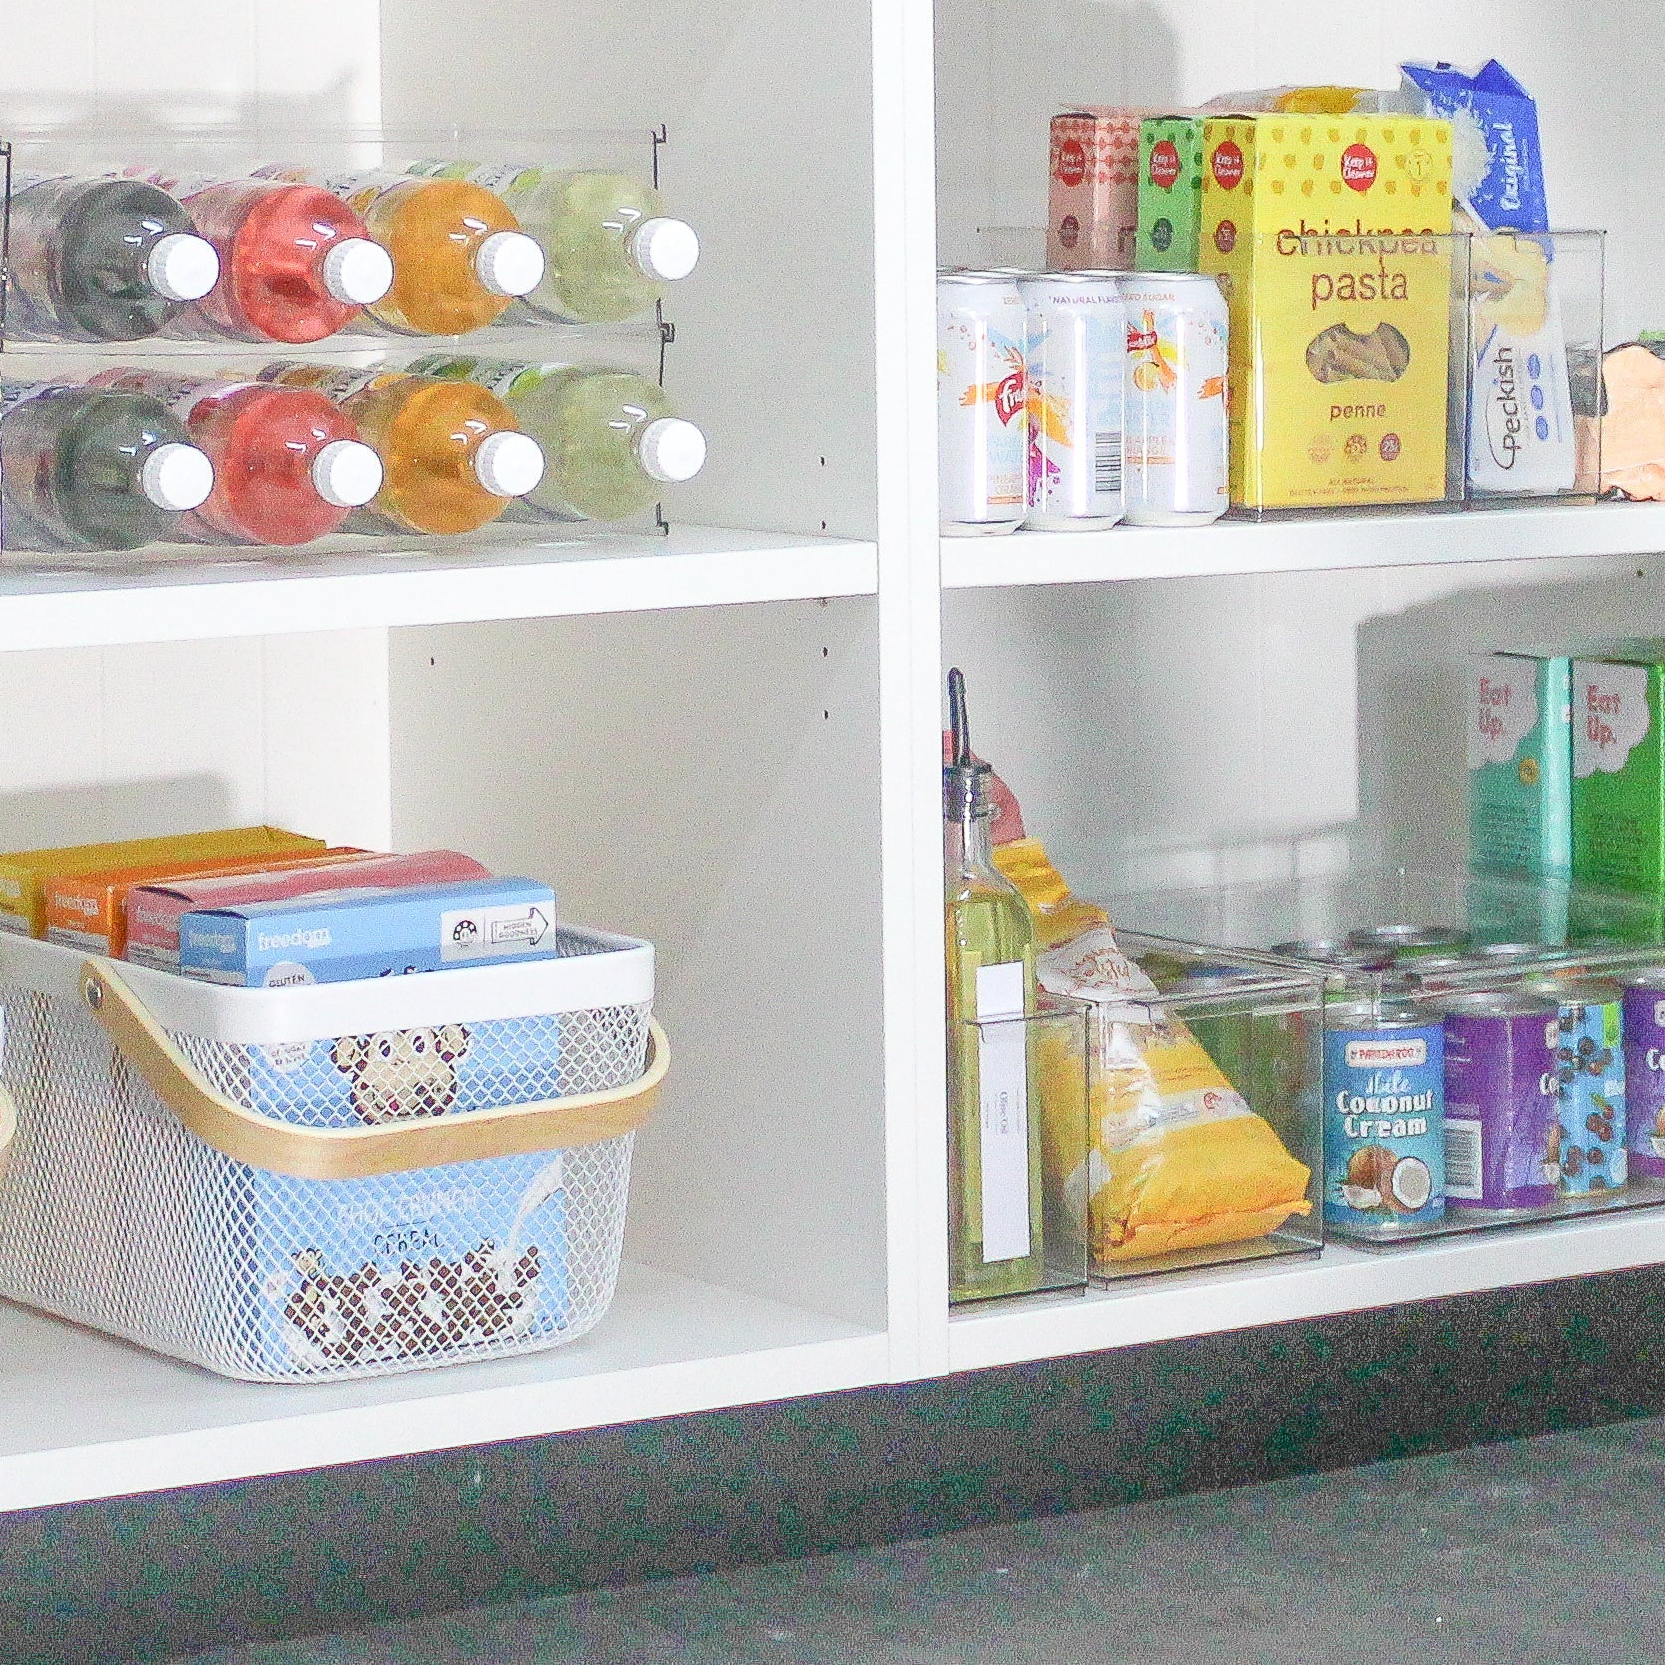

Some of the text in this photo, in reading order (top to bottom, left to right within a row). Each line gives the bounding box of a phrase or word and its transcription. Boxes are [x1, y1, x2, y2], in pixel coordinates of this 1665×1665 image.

[1311, 256, 1409, 311] pasta
[1329, 401, 1387, 421] penne
[1335, 1089, 1435, 1116] Coconut
[1343, 1114, 1428, 1139] Cream
